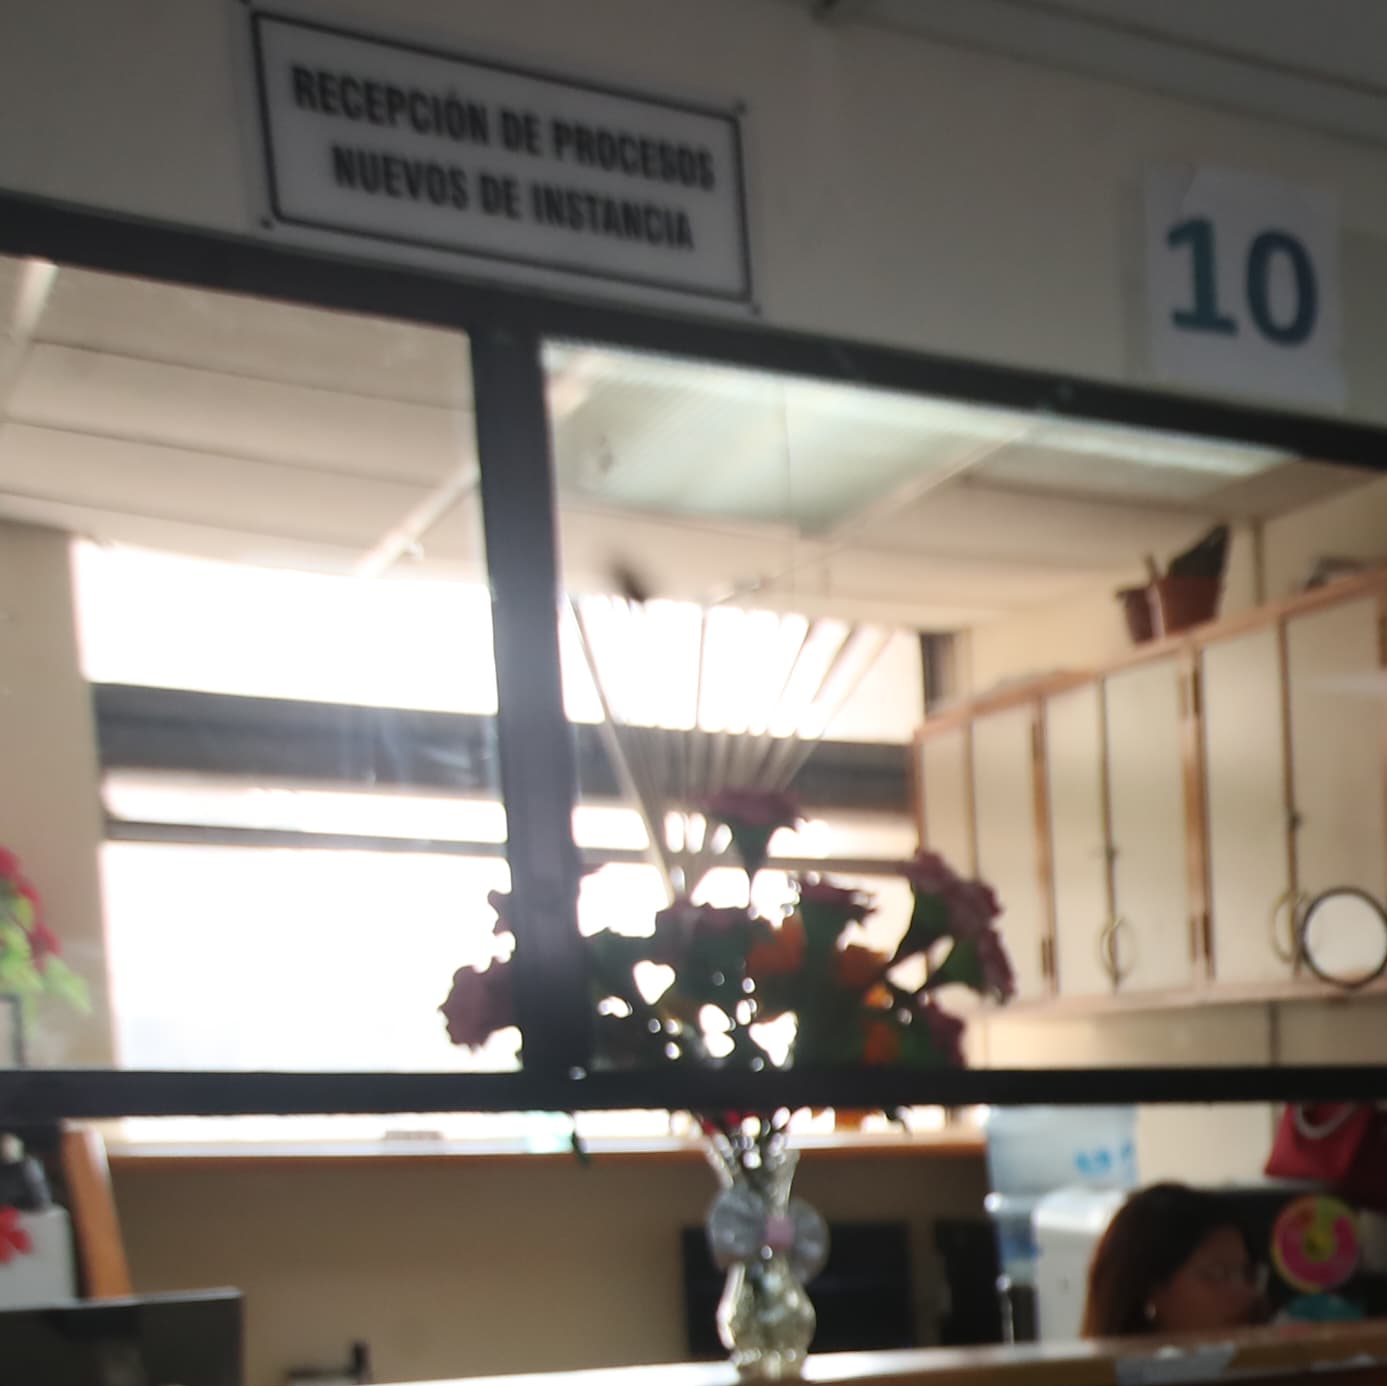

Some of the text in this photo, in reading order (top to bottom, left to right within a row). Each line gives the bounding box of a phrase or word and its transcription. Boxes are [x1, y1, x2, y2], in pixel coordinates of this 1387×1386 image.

[289, 65, 715, 191] RECEPCIÓN DE PROCESOS
[330, 146, 694, 250] NUEVOS DE INSTANCIA
[1167, 215, 1318, 347] 10
